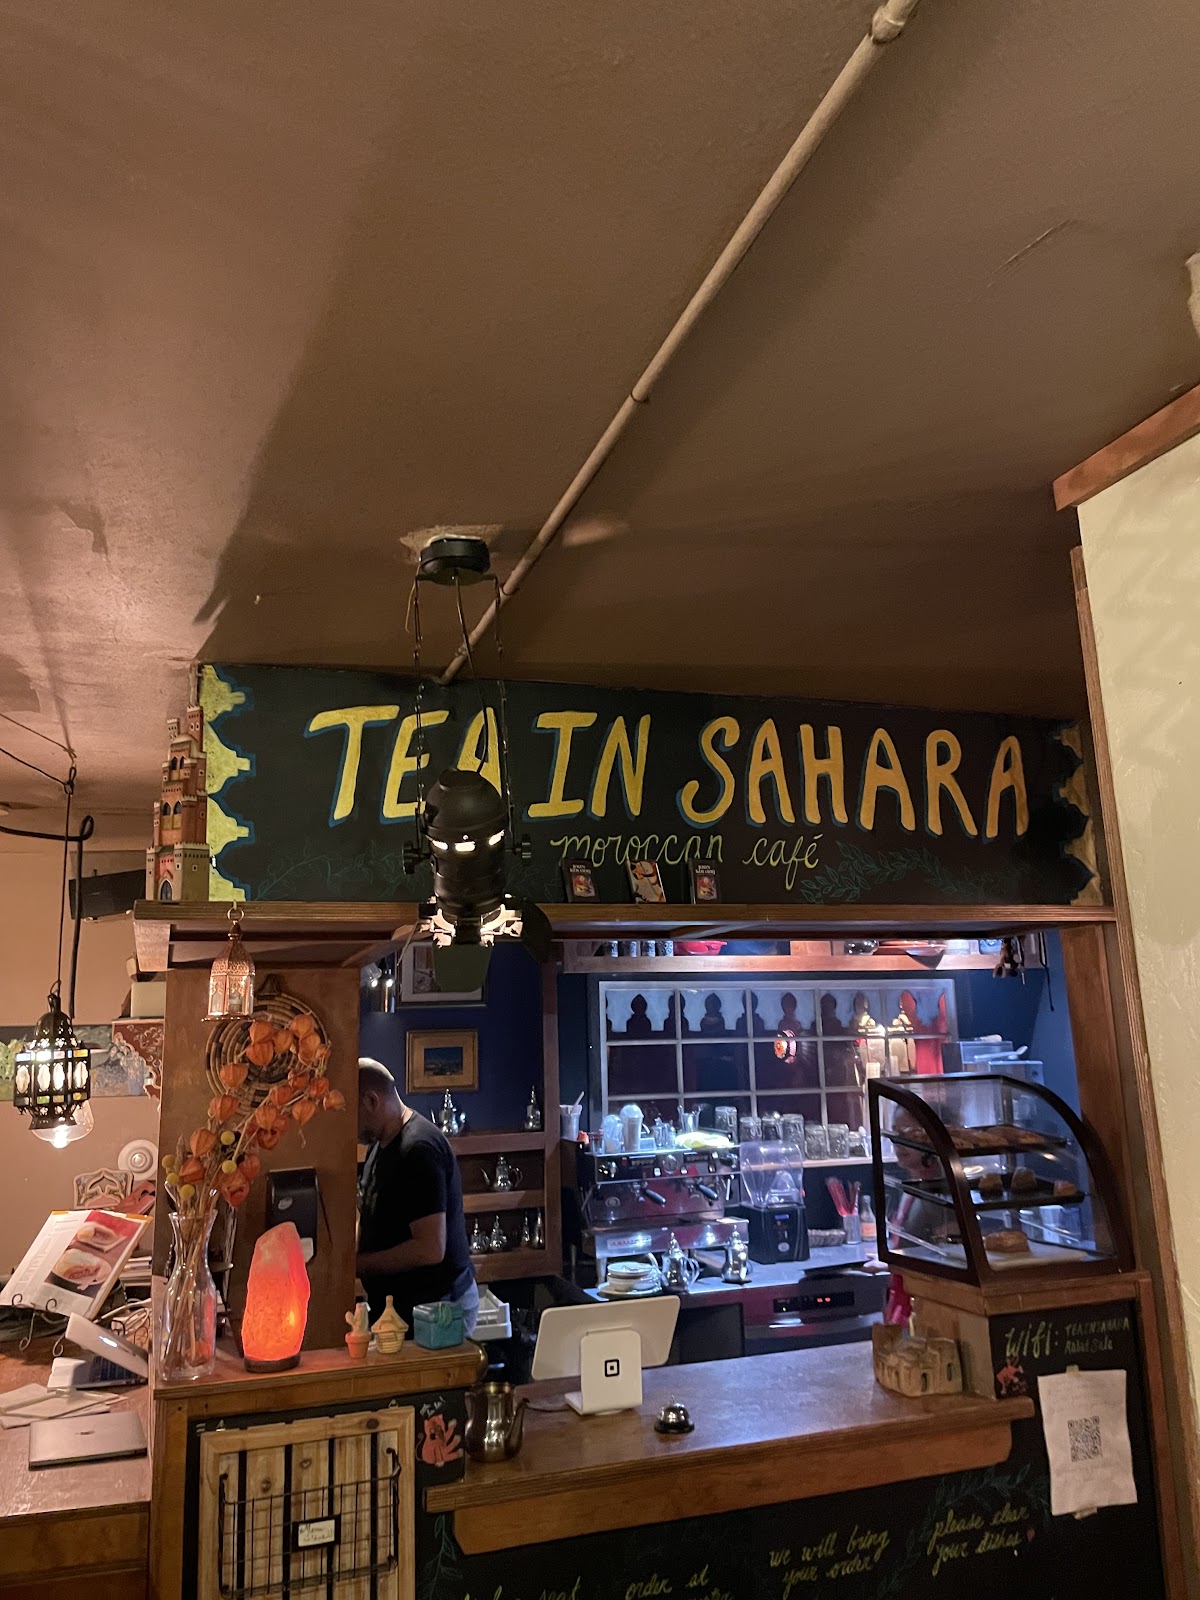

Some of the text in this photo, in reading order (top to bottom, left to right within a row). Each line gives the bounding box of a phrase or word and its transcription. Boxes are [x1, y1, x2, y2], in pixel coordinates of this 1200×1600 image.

[305, 705, 1030, 841] TEA IN SAHARA
[550, 833, 824, 891] moroccan café
[769, 1525, 890, 1568] we will bring
[927, 1509, 984, 1556] please
[931, 1530, 1024, 1577] your dishes
[624, 1573, 673, 1600] order
[685, 1563, 710, 1590] at
[782, 1554, 873, 1600] your order
